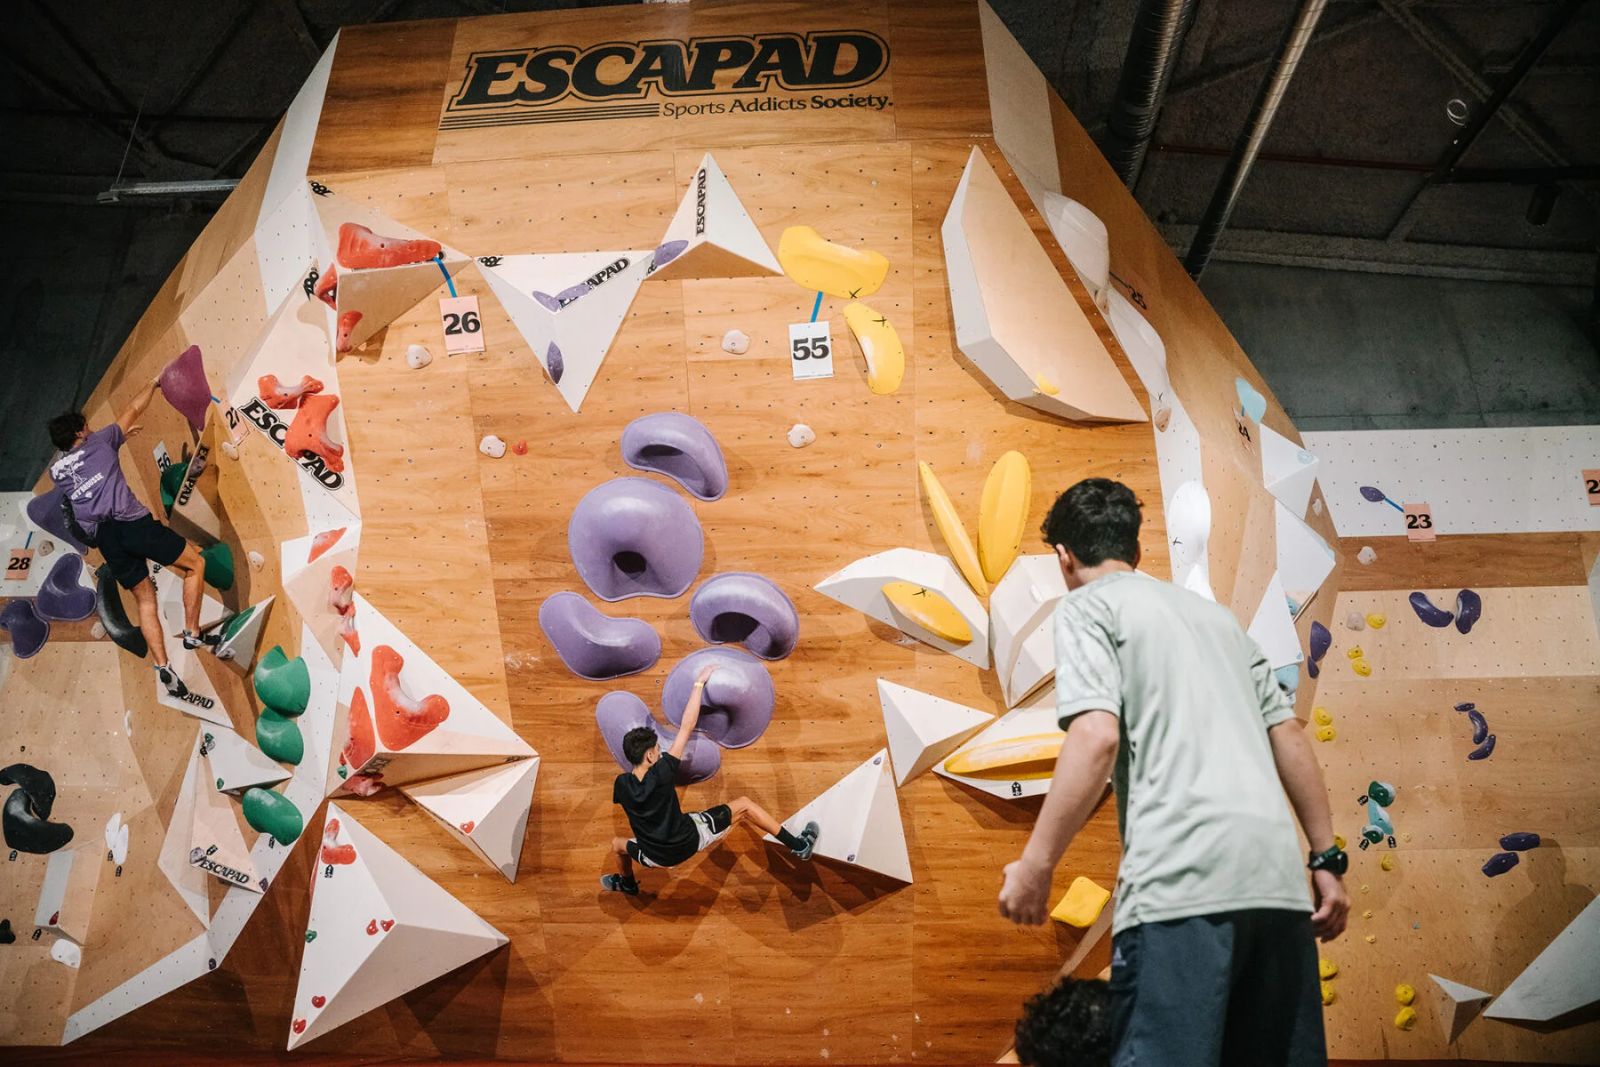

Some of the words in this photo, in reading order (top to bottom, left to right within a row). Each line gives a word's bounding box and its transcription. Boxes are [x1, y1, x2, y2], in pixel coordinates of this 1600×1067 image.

[448, 30, 890, 112] ESCAPAD
[663, 101, 725, 120] Sports
[729, 97, 807, 114] Addicts
[811, 93, 894, 112] Society.
[695, 167, 707, 237] ESCAPAD
[442, 311, 481, 336] 26
[792, 335, 830, 361] 55
[239, 397, 343, 490] ESCAD
[1586, 479, 1600, 494] 2
[1406, 513, 1433, 530] 23
[8, 556, 31, 571] 28
[200, 858, 250, 885] ESCAPAD
